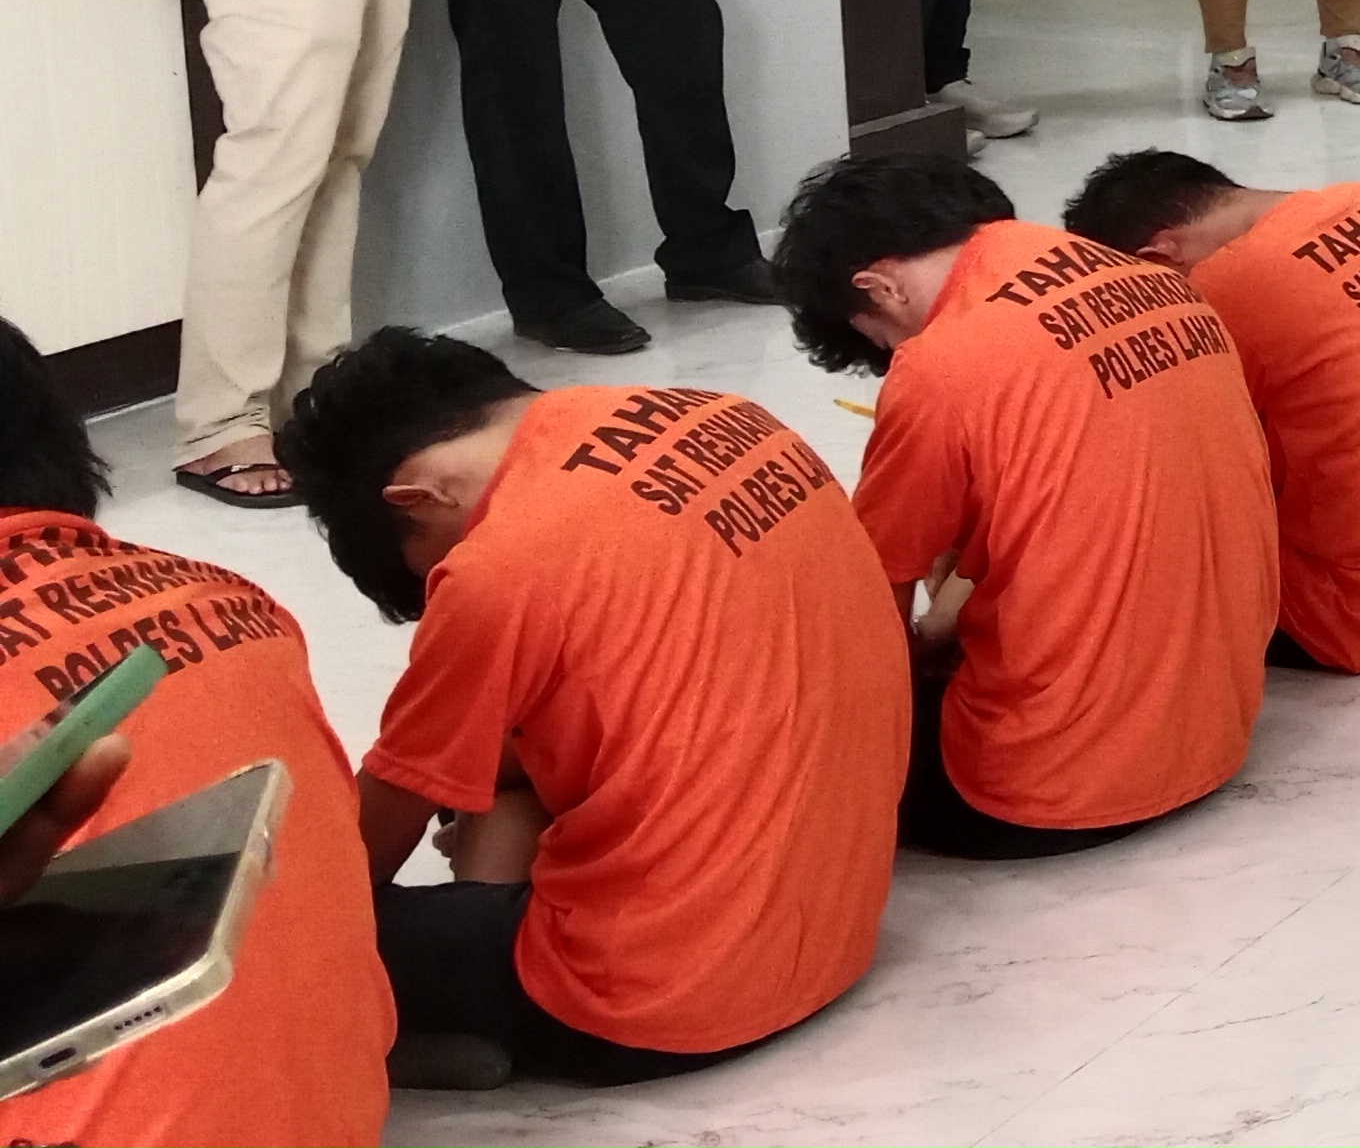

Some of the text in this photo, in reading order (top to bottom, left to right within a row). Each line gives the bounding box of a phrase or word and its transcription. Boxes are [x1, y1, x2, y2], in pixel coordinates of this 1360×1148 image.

[1038, 297, 1096, 350] SAT
[1088, 315, 1230, 399] POLRES LAHAT
[630, 453, 706, 515] SAT
[704, 459, 808, 558] POLRES
[0, 596, 51, 666] AT
